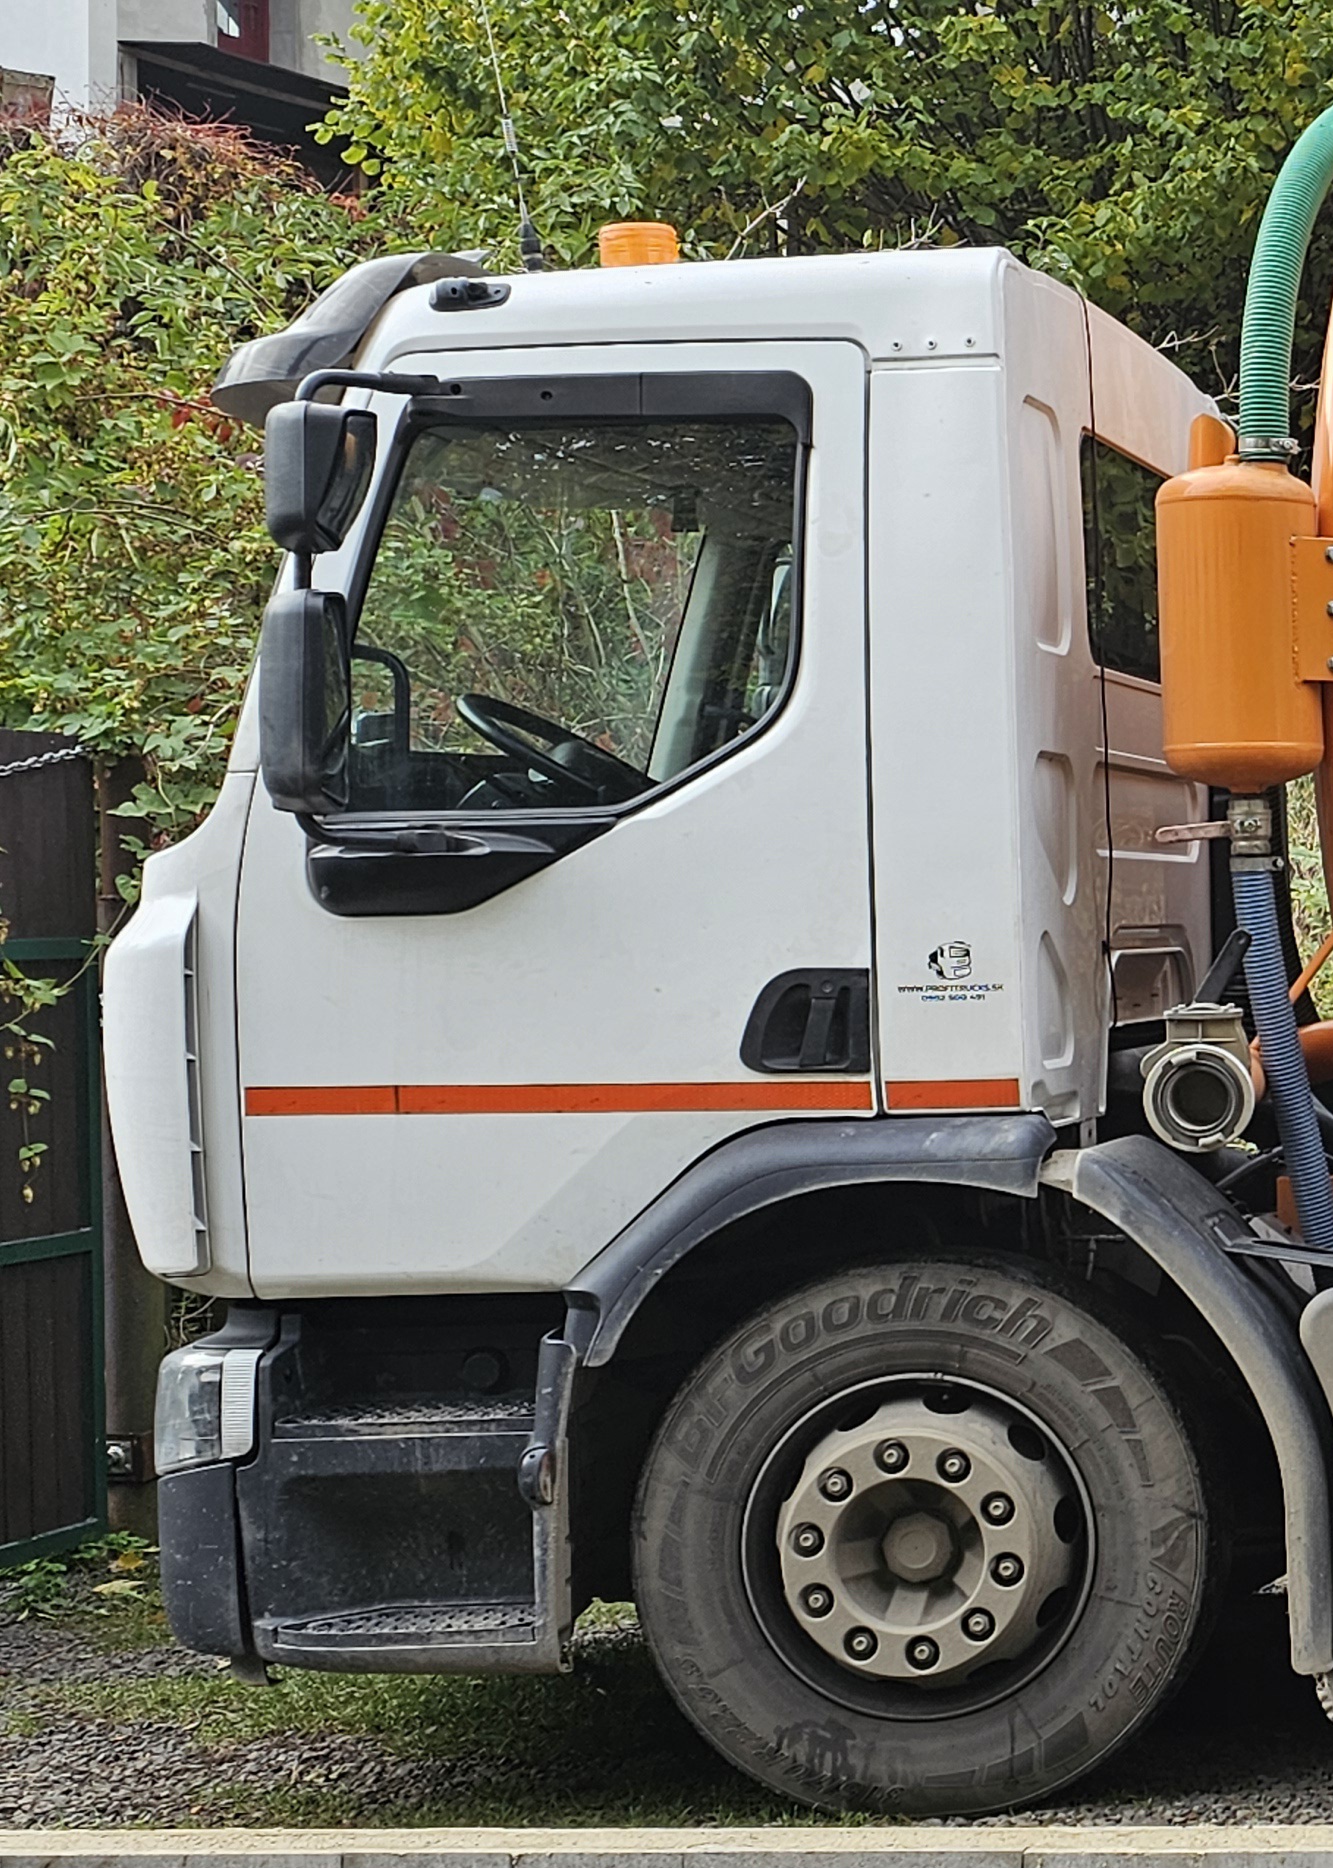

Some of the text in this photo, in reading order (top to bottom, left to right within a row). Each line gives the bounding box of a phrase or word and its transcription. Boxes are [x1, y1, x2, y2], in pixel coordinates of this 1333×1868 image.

[664, 1275, 1053, 1468] BFGoodrich
[1088, 1571, 1163, 1712] CONTROL
[1129, 1589, 1189, 1708] ROUTE
